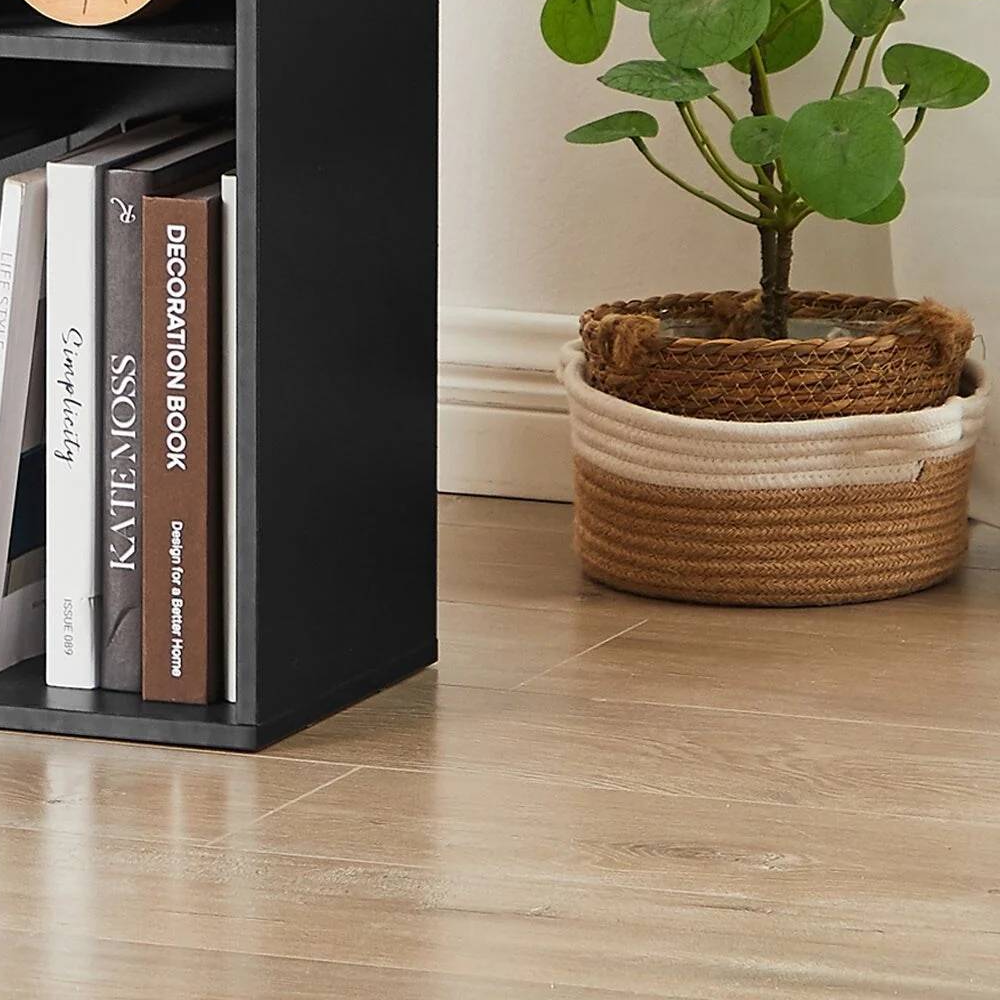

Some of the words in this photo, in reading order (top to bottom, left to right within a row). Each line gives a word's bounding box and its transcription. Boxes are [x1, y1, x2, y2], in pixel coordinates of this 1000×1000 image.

[166, 224, 186, 390] DECORATION
[54, 327, 84, 471] Simplicity
[110, 354, 136, 464] MOSS
[166, 395, 187, 471] BOOK
[110, 468, 136, 570] KATE
[169, 521, 183, 564] Design
[171, 567, 184, 585] for
[171, 587, 182, 596] a
[63, 598, 74, 632] ISSUE
[171, 598, 183, 637] Better
[63, 634, 74, 656] 089
[171, 638, 183, 677] Home
